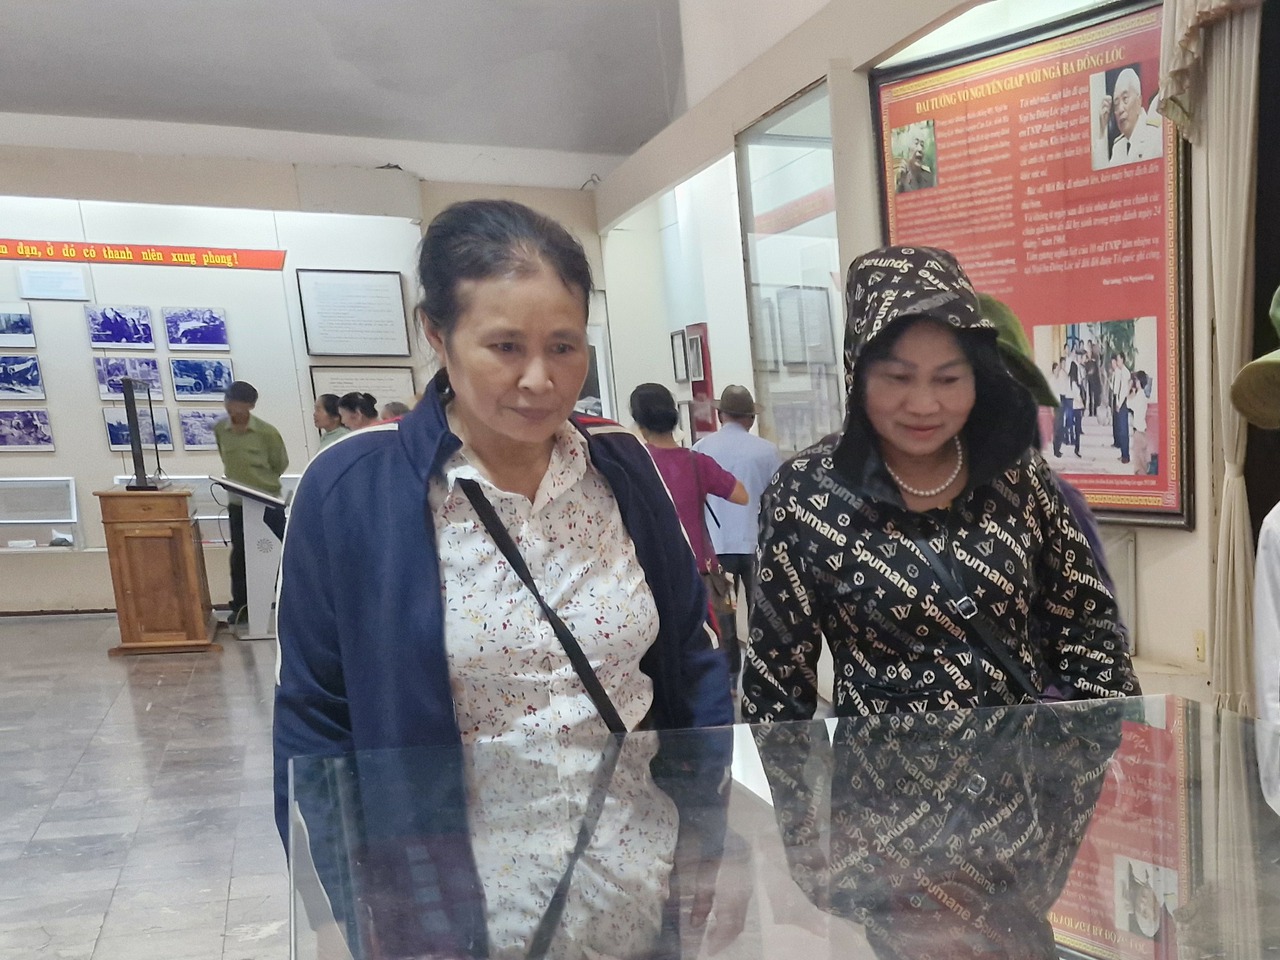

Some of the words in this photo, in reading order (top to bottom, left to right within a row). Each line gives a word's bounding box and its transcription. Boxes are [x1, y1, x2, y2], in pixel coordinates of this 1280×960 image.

[1063, 61, 1076, 75] BA
[62, 243, 76, 257] đó
[83, 245, 96, 258] có
[103, 246, 133, 260] thanh
[142, 248, 163, 262] niên
[172, 252, 196, 265] xung
[203, 252, 239, 267] phong!
[787, 496, 847, 547] Spumane
[773, 541, 812, 617] Spumane
[851, 540, 918, 599] Spumane
[1074, 677, 1127, 698] Spuman
